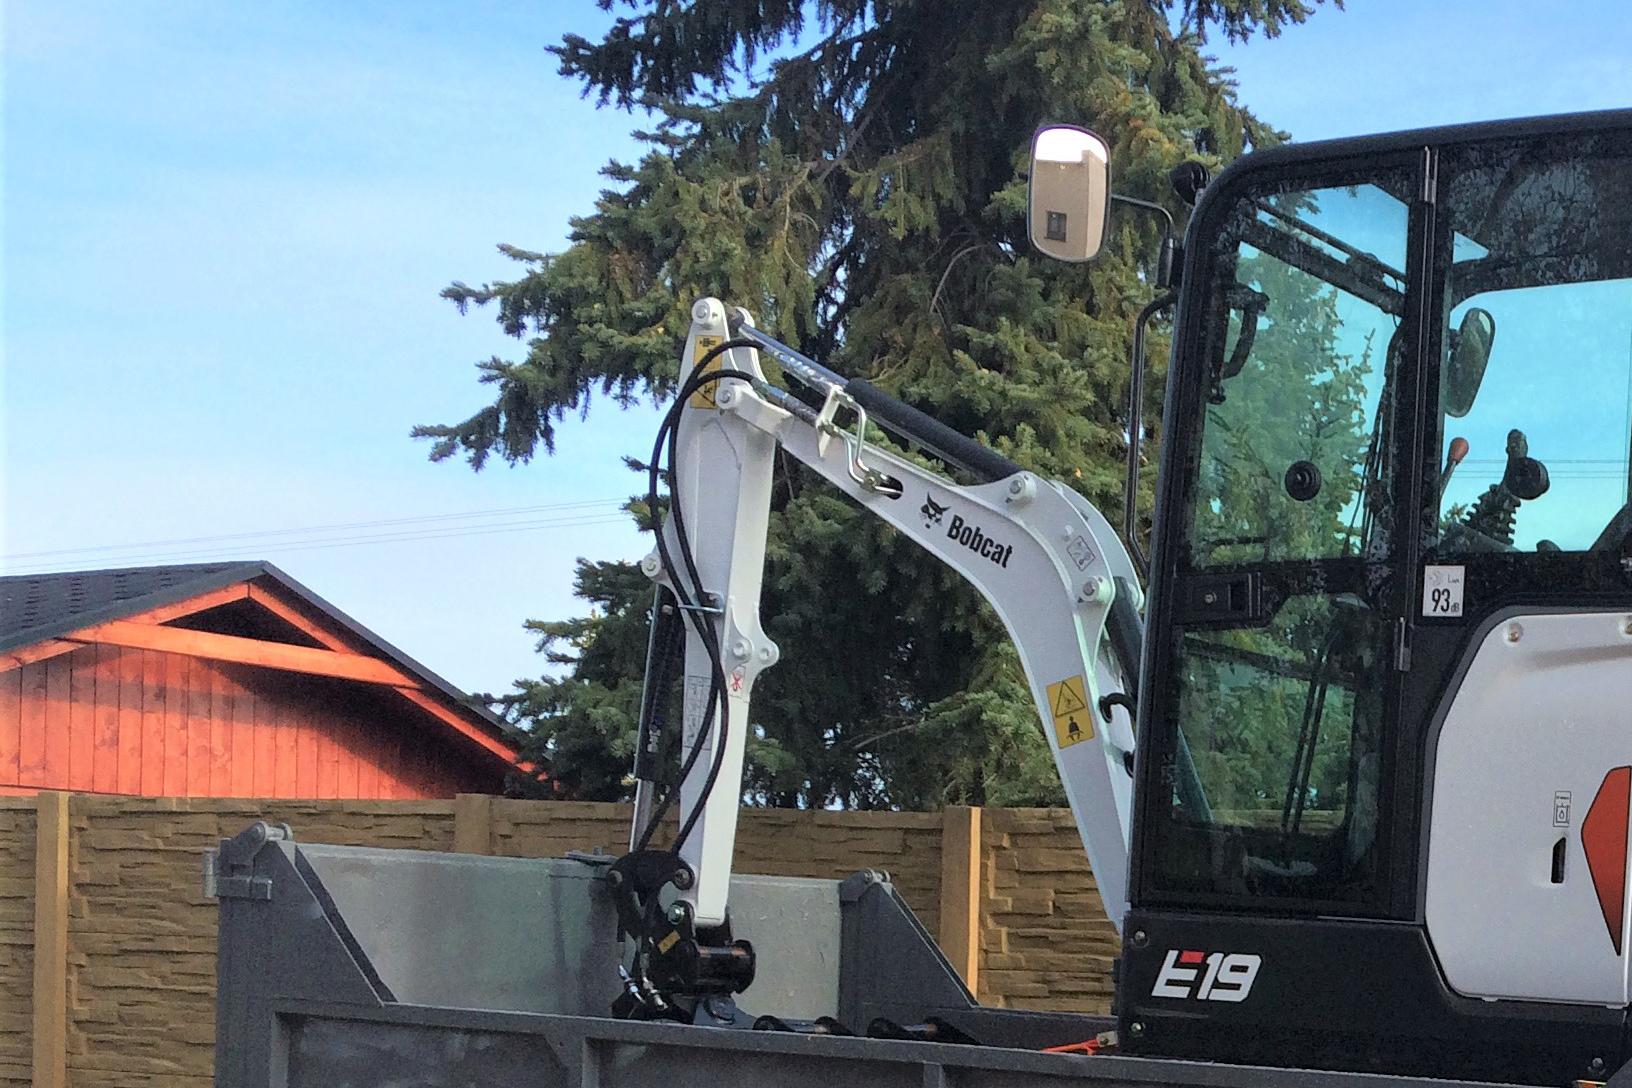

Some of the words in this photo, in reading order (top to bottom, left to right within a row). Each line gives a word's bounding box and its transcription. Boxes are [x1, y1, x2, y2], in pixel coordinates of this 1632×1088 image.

[947, 514, 1013, 568] Bobcat
[1432, 588, 1450, 612] 93
[1151, 949, 1262, 1002] E19
